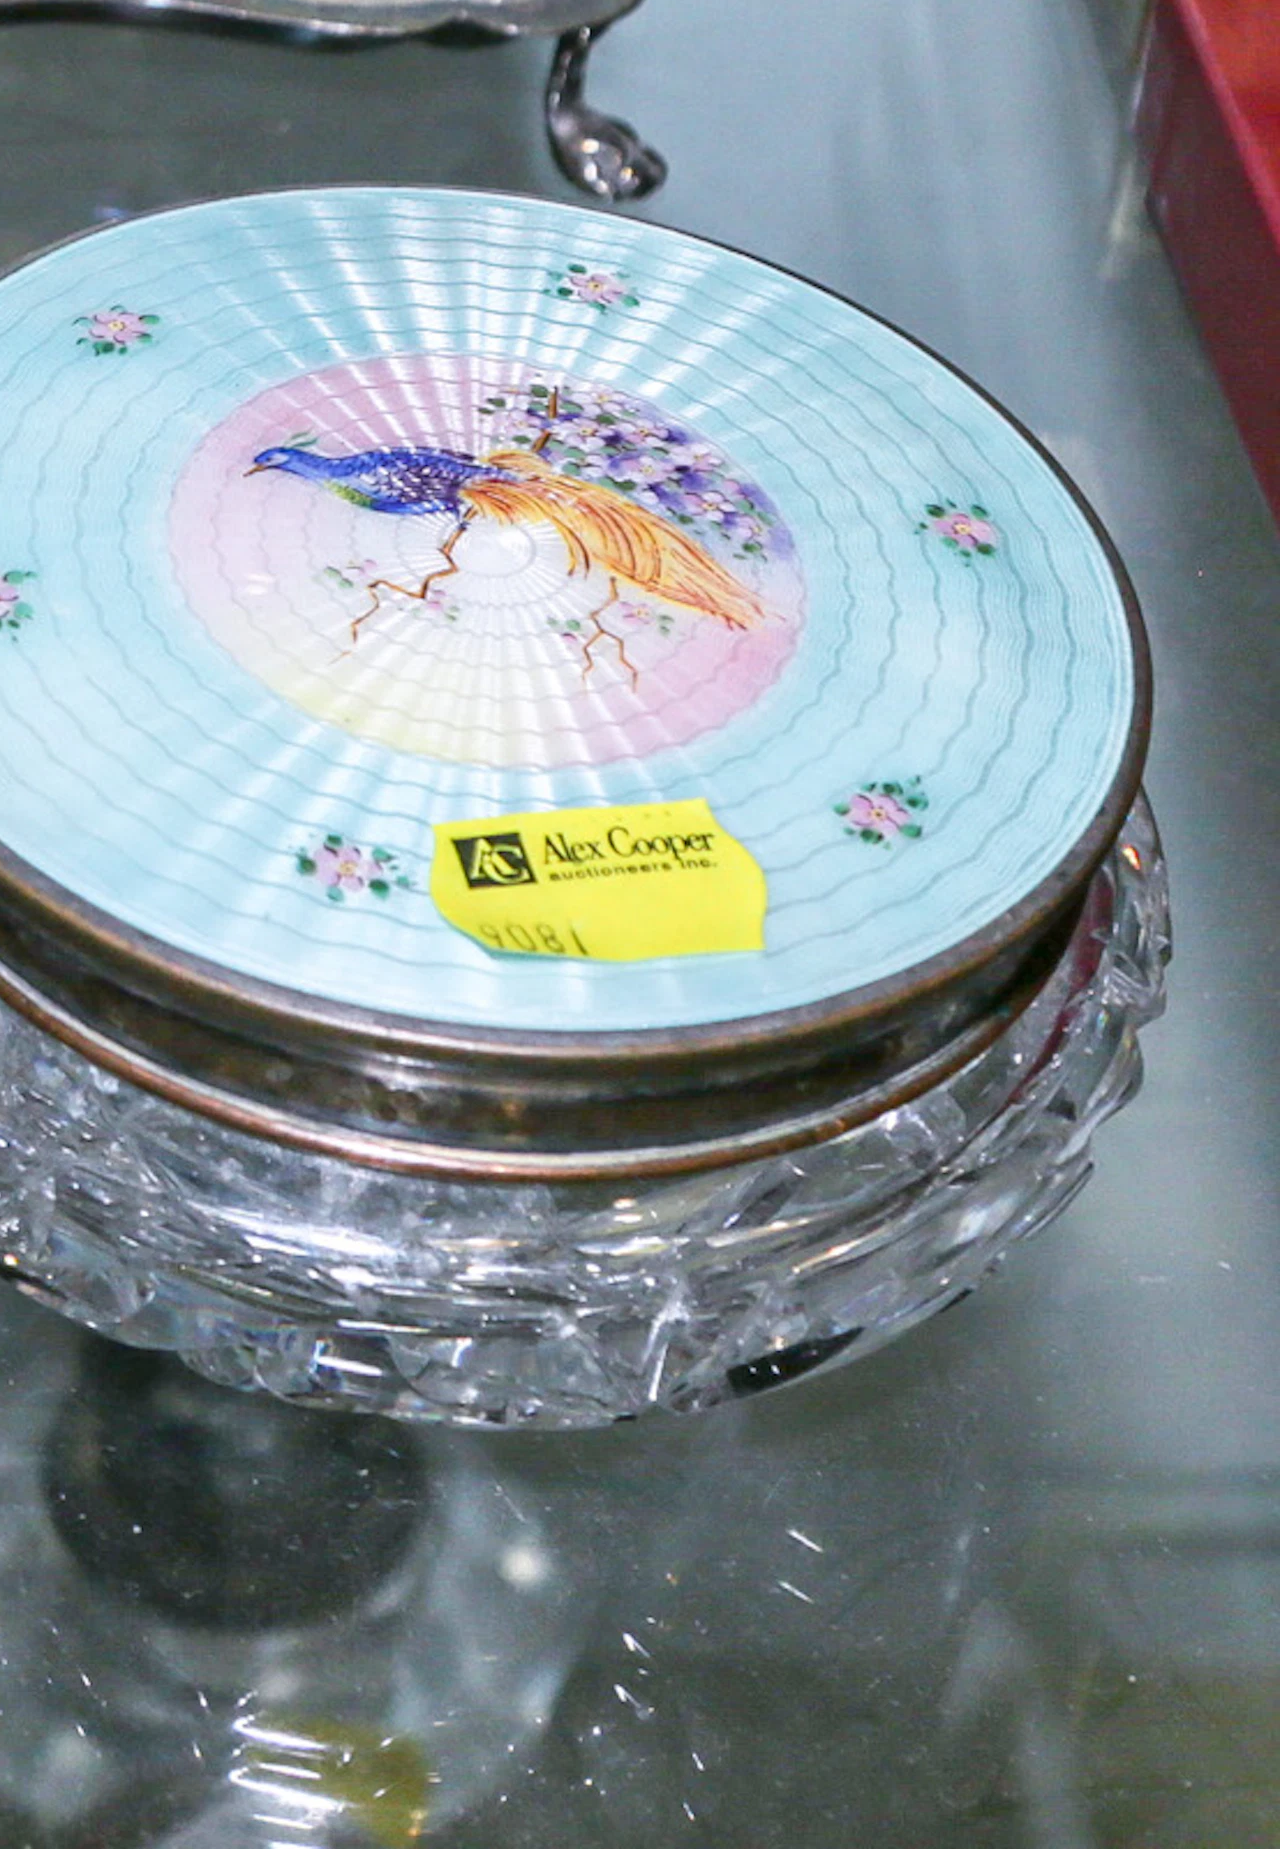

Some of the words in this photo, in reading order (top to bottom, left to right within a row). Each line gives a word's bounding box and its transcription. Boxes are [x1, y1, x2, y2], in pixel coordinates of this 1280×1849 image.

[543, 831, 605, 865] Alex
[607, 825, 715, 861] Cooper
[548, 862, 672, 882] auctioneers
[479, 920, 589, 956] 9081
